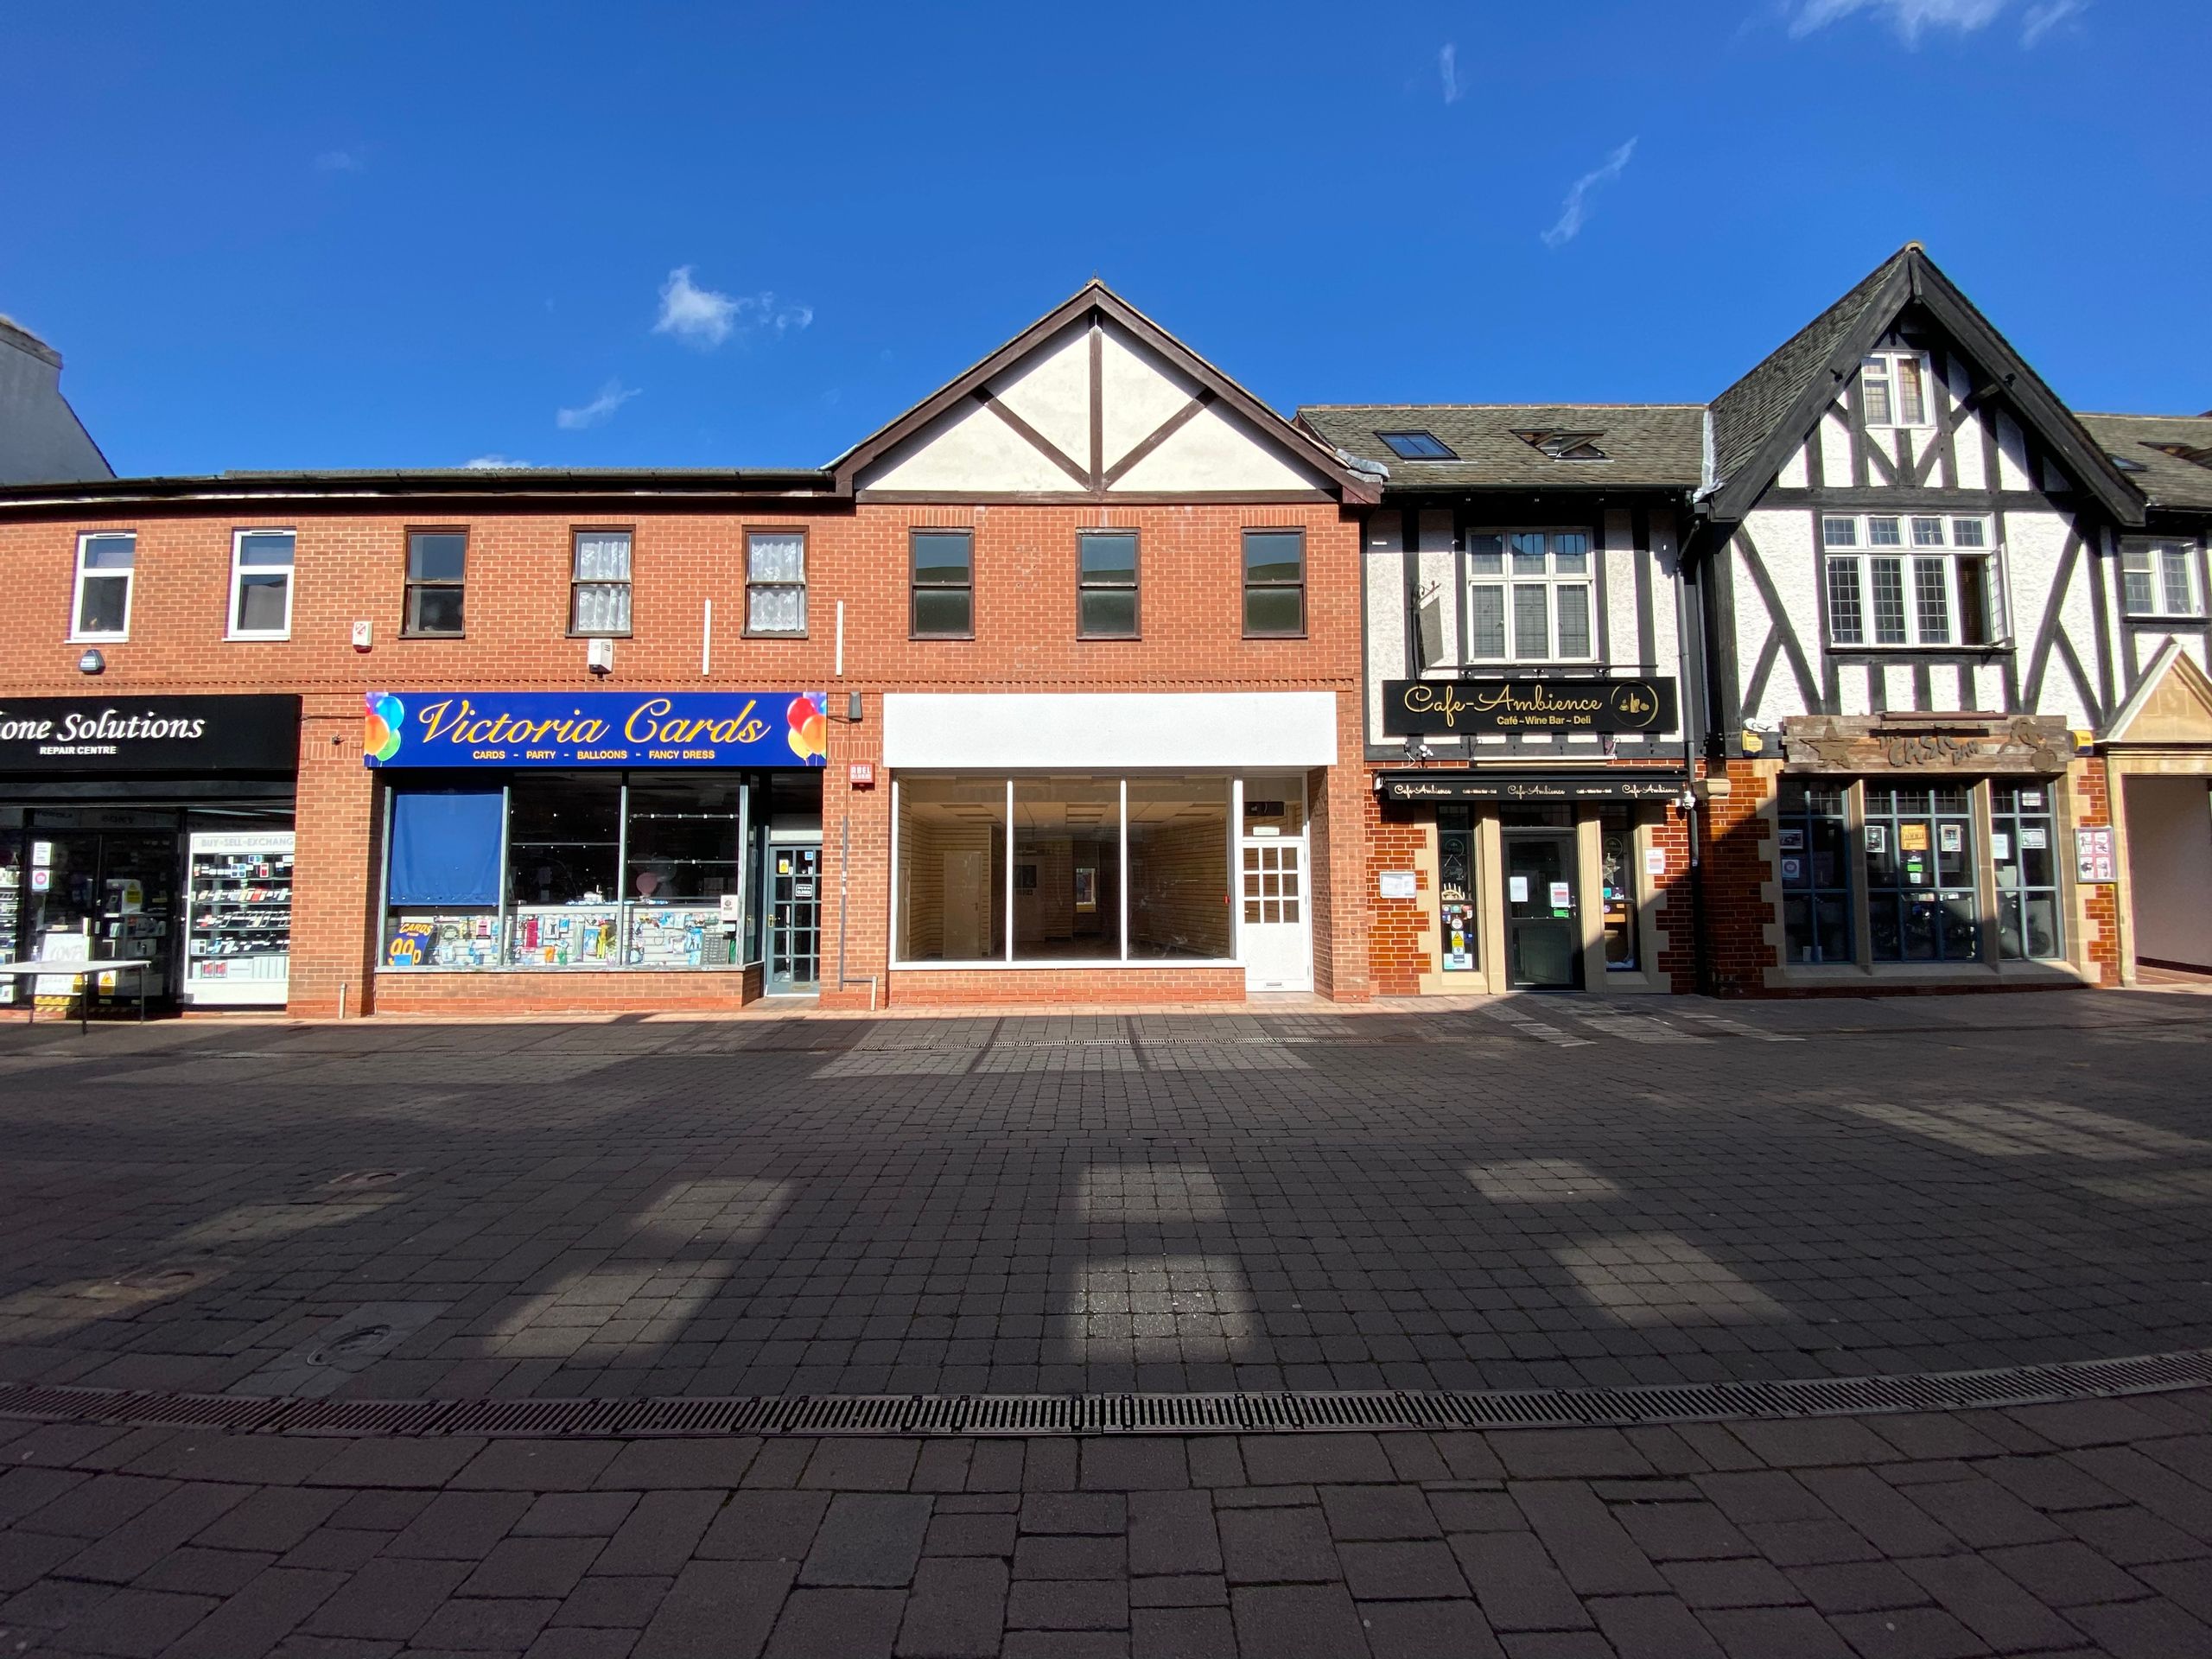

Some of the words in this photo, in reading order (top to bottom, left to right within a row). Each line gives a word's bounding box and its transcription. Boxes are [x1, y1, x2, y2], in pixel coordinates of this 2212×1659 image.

[1404, 684, 1602, 728] Cafe-Ambience
[0, 712, 53, 741] one
[57, 709, 206, 741] Solutions
[418, 699, 610, 744] Victoria
[625, 698, 771, 743] Cards
[1497, 715, 1518, 725] Café
[1525, 715, 1548, 725] Wine
[1548, 715, 1566, 725] Bar
[1573, 715, 1591, 724] Deli
[40, 747, 74, 755] REPAIR
[77, 747, 117, 755] CENTRE
[473, 750, 505, 760] CARDS
[526, 750, 556, 759] PARTY
[576, 750, 627, 760] BALLOONS
[649, 750, 679, 760] FANCY
[683, 750, 715, 760] DRESS
[399, 923, 434, 936] CARDS
